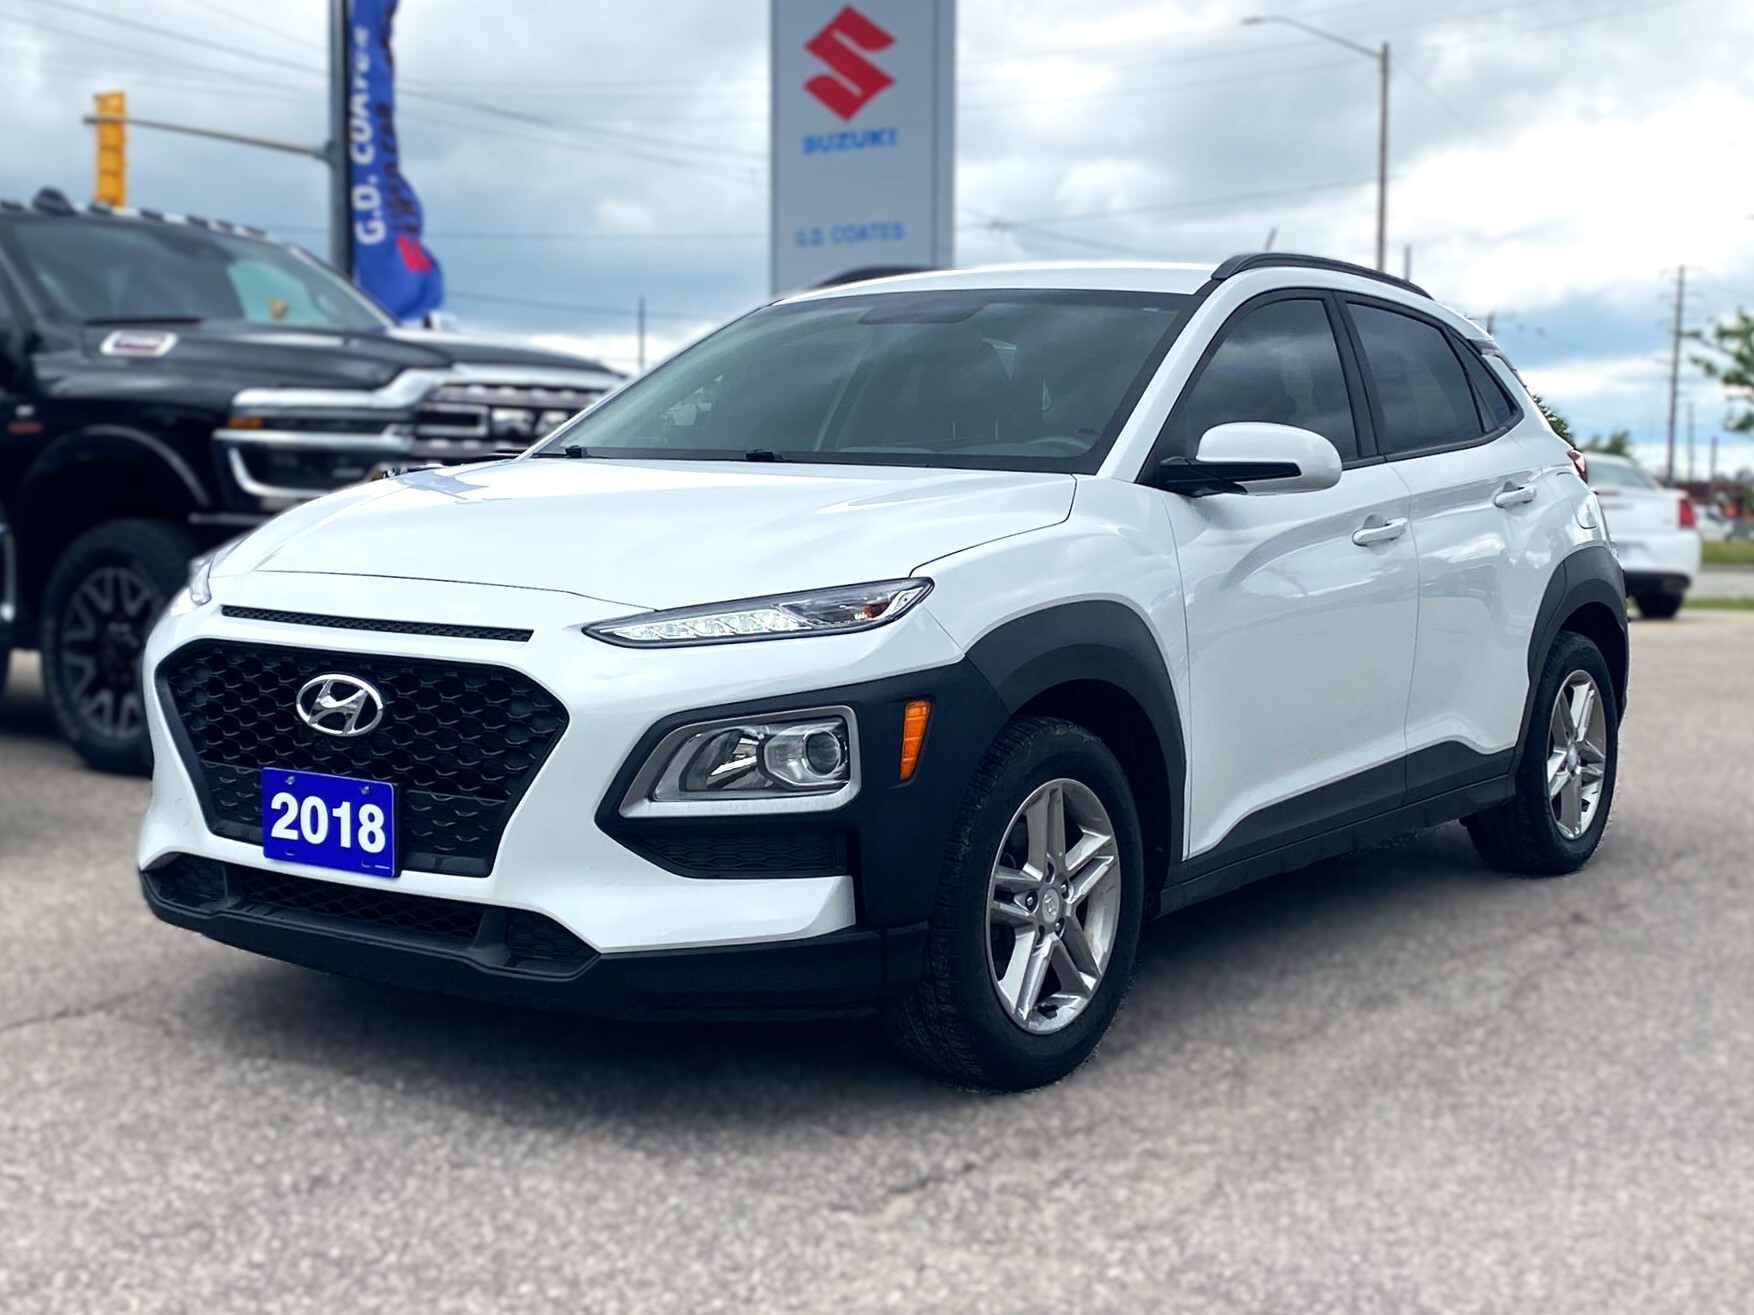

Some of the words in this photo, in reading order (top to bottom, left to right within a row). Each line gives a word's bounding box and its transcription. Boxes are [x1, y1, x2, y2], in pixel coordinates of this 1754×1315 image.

[803, 127, 897, 155] SUZUKI
[352, 175, 386, 245] G.D.
[830, 221, 904, 243] COATES
[270, 791, 386, 853] 2018
